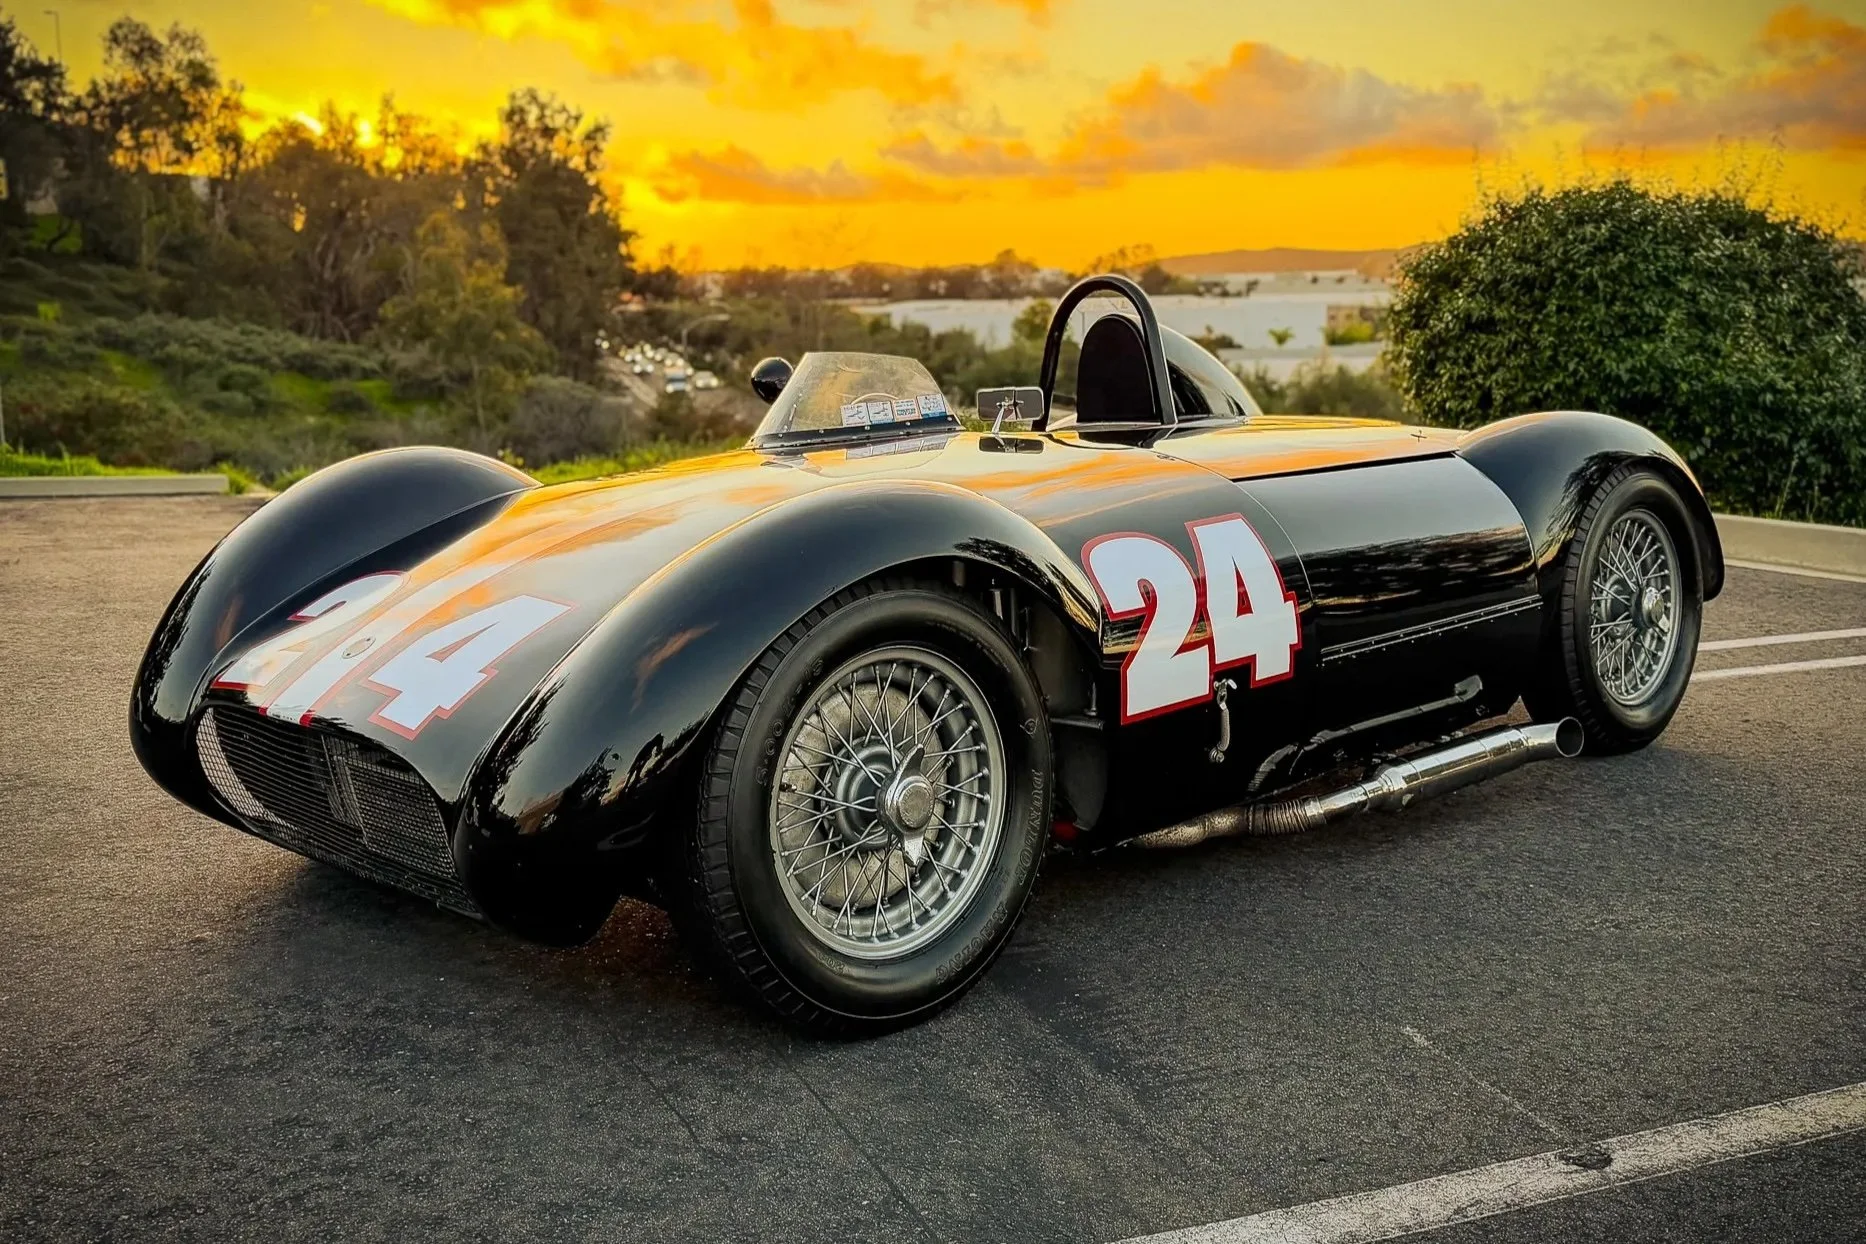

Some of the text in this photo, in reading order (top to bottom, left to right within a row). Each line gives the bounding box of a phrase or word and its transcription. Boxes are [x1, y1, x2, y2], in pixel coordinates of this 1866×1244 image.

[211, 569, 581, 741] 24
[1081, 512, 1303, 726] 24
[935, 901, 1009, 985] RACING
